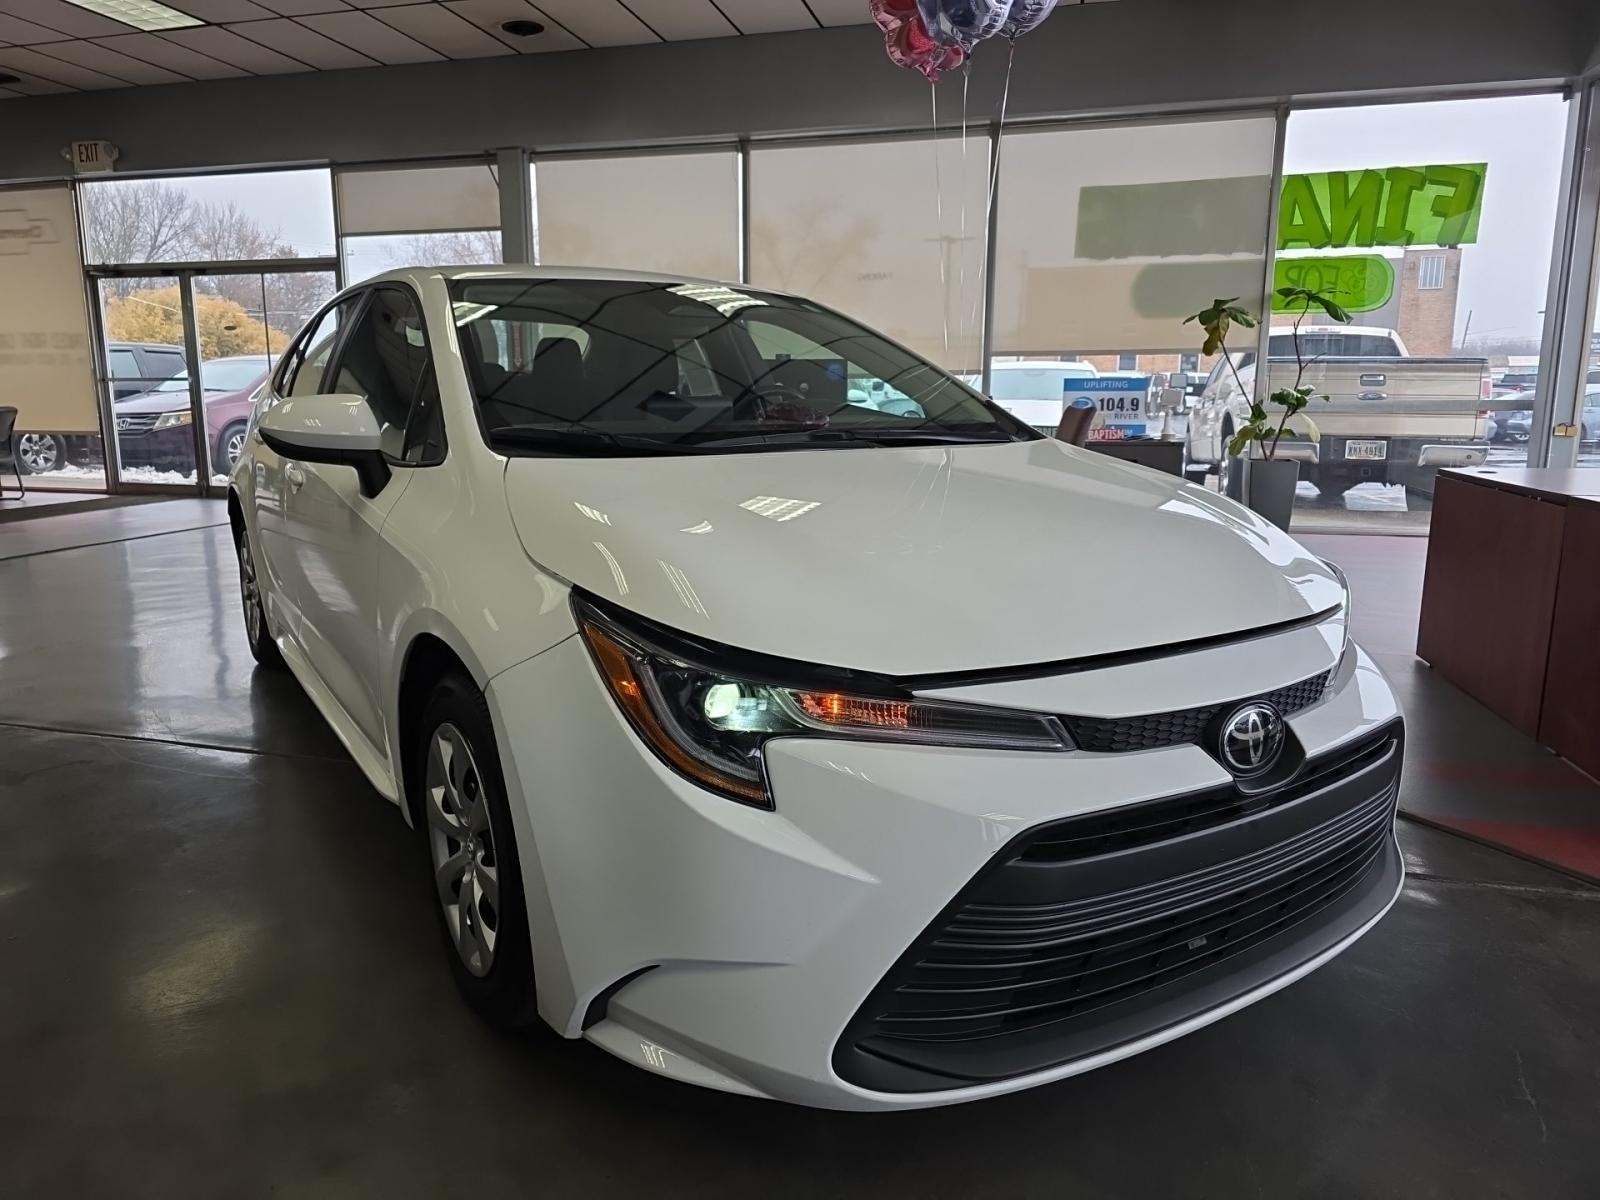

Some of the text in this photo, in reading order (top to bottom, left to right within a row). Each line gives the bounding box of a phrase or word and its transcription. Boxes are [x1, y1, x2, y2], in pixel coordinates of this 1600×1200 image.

[78, 143, 98, 162] EXIT
[1083, 380, 1129, 389] UPLIFTING
[1099, 397, 1140, 411] 104.9
